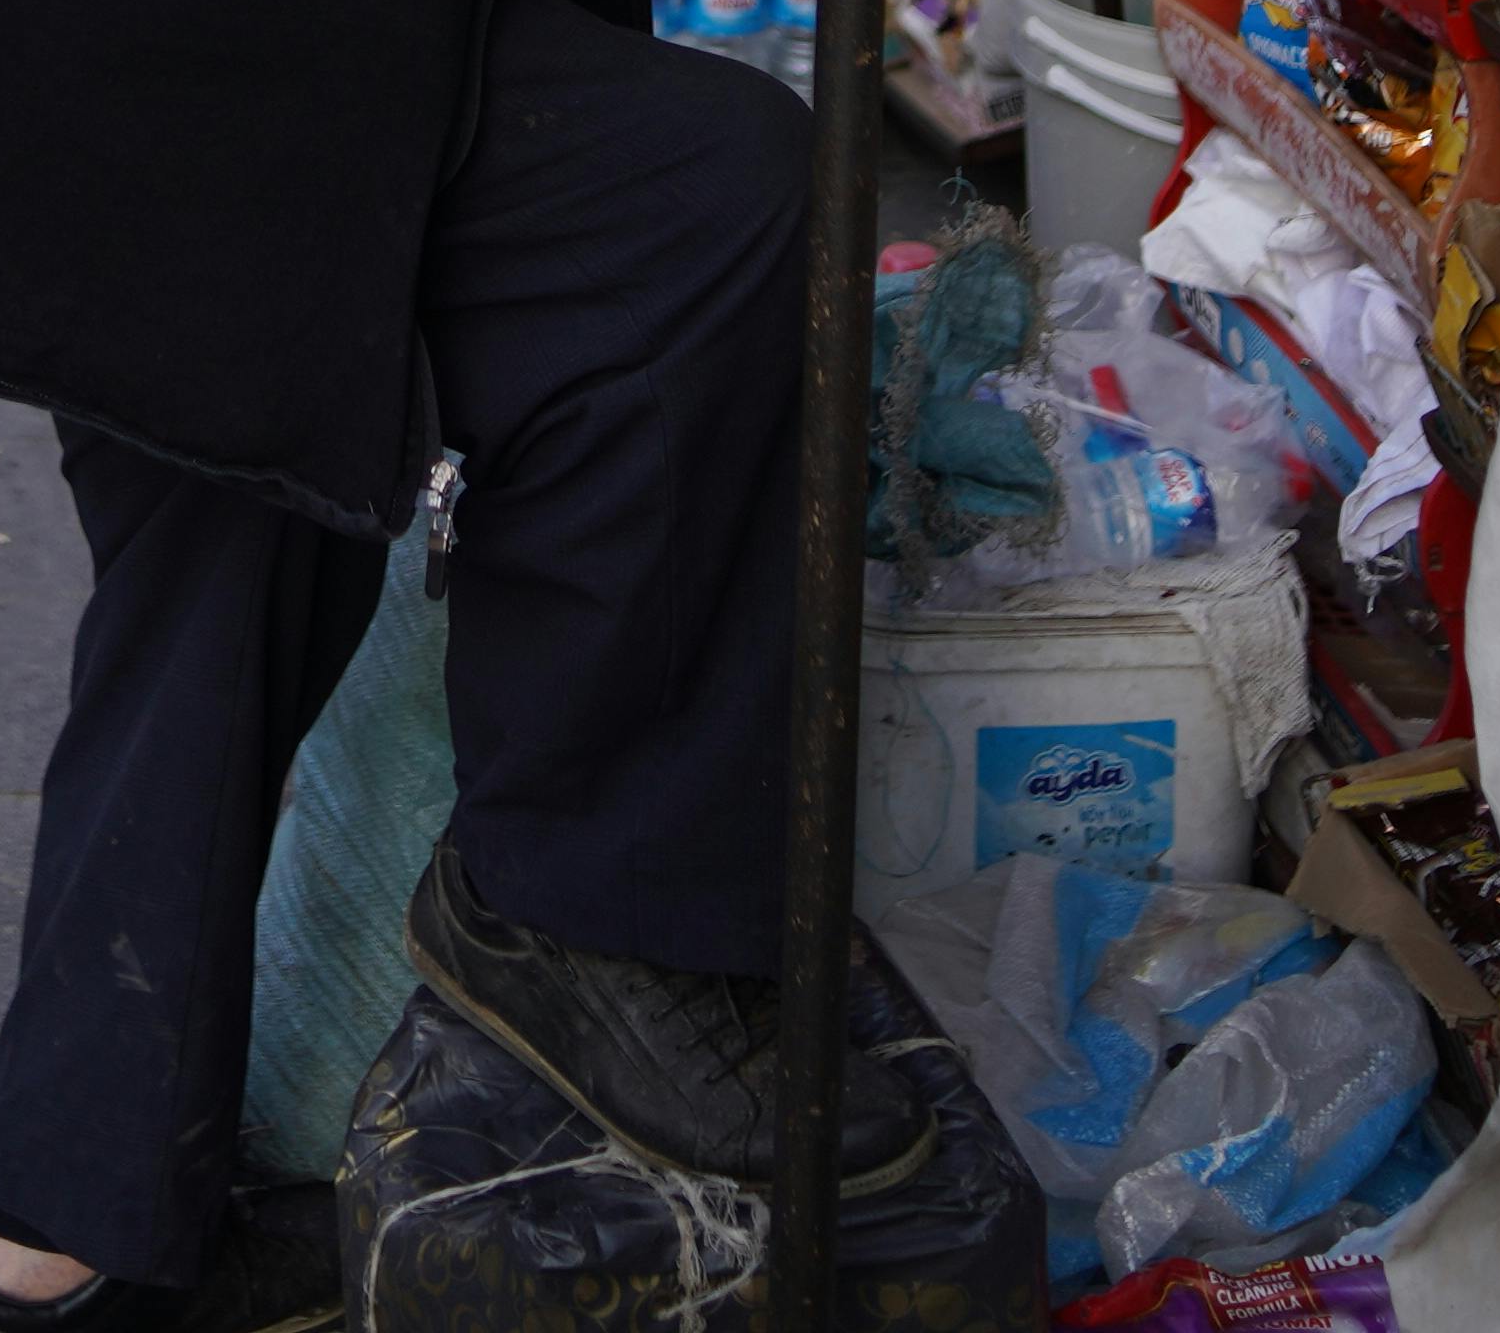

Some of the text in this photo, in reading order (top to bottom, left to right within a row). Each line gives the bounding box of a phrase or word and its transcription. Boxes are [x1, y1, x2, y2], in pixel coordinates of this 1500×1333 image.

[1027, 759, 1128, 802] ayda
[1208, 1270, 1292, 1290] EXCELLENT
[1216, 1279, 1296, 1306] CLEANING
[1226, 1294, 1302, 1321] FORMULA
